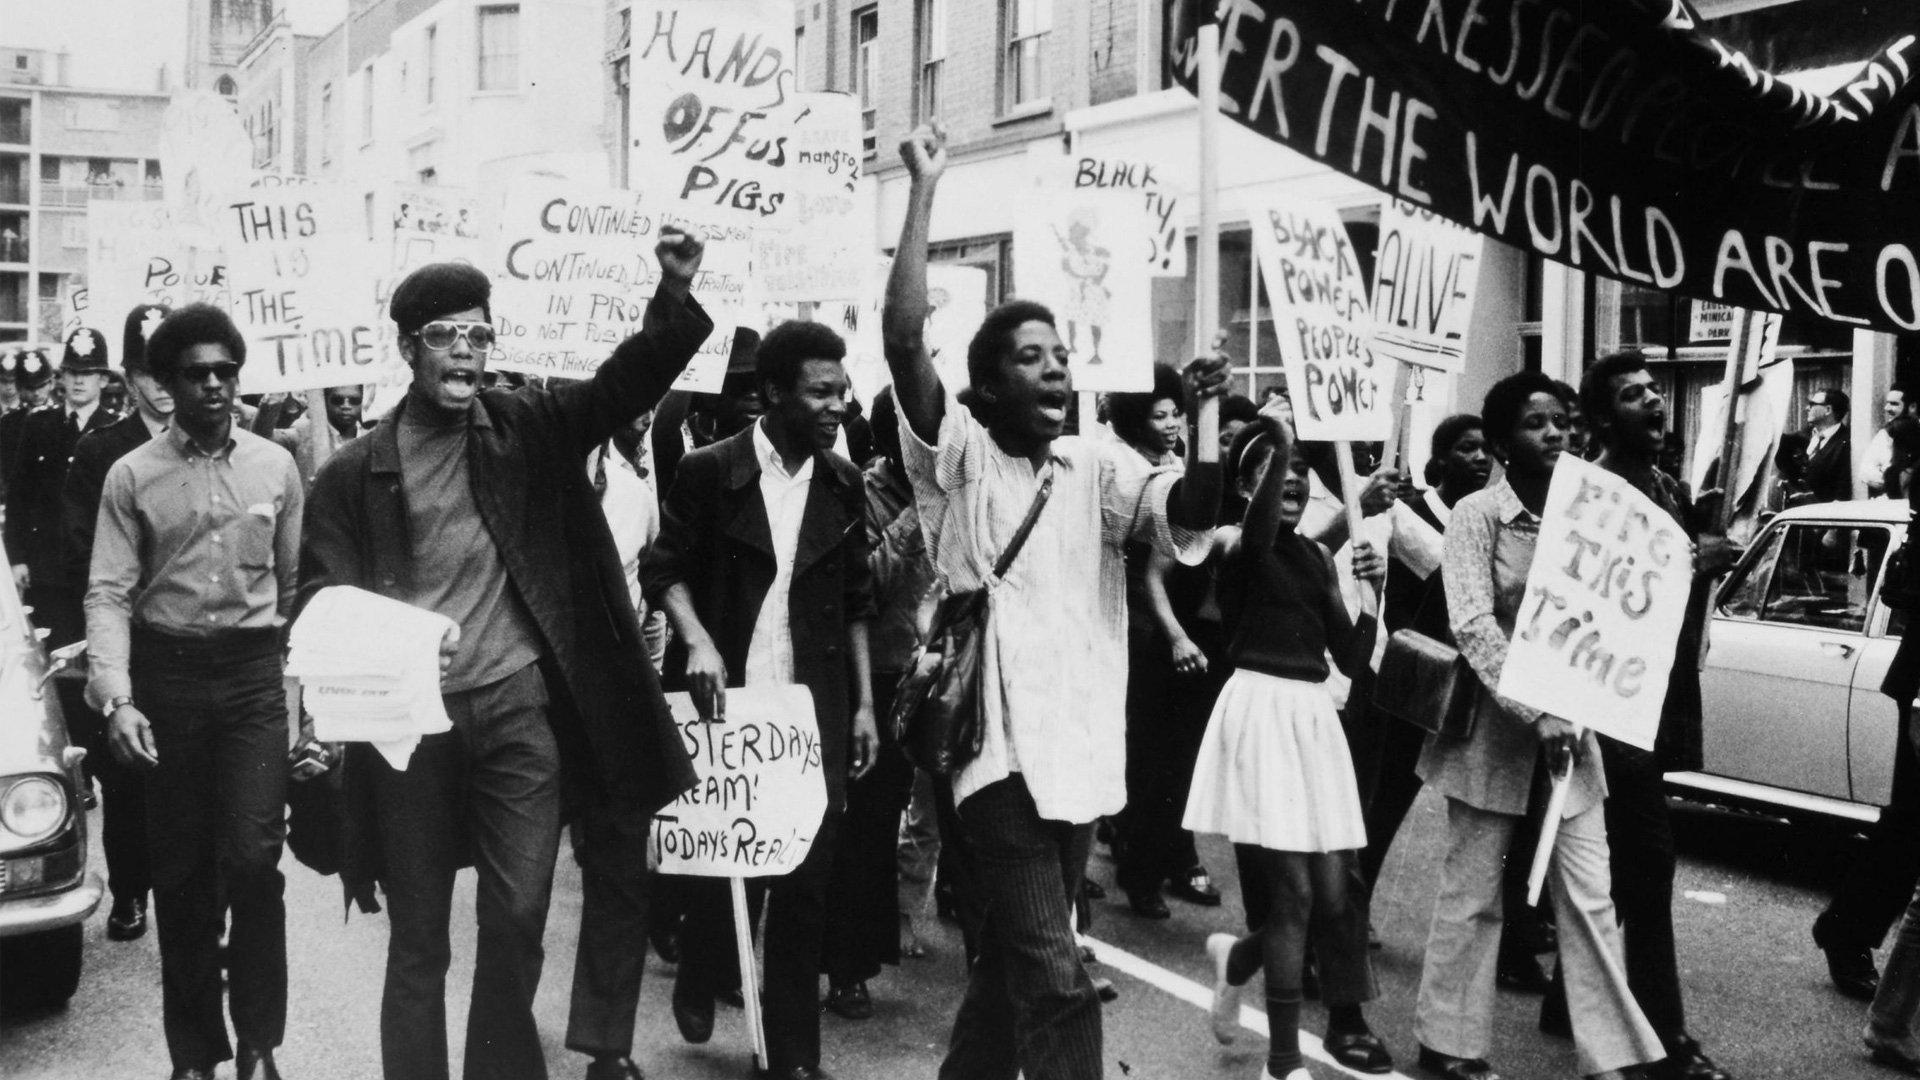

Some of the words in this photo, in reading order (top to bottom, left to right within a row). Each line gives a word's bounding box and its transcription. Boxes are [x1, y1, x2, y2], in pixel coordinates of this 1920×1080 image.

[641, 10, 793, 109] HANDS
[663, 92, 767, 163] OFF
[745, 136, 788, 167] US
[680, 165, 785, 216] PIGS
[1075, 158, 1158, 188] BLACK
[1315, 44, 1438, 204] THE
[1466, 130, 1687, 289] WORLD
[1714, 229, 1871, 325] ARE
[230, 201, 316, 243] THIS
[540, 198, 650, 238] CONTINUED
[1268, 209, 1353, 281] BLACK
[242, 289, 303, 325] THE
[547, 294, 573, 316] IN
[1374, 230, 1475, 341] ALIVE
[1700, 311, 1734, 323] MINICA
[257, 326, 374, 376] TIME
